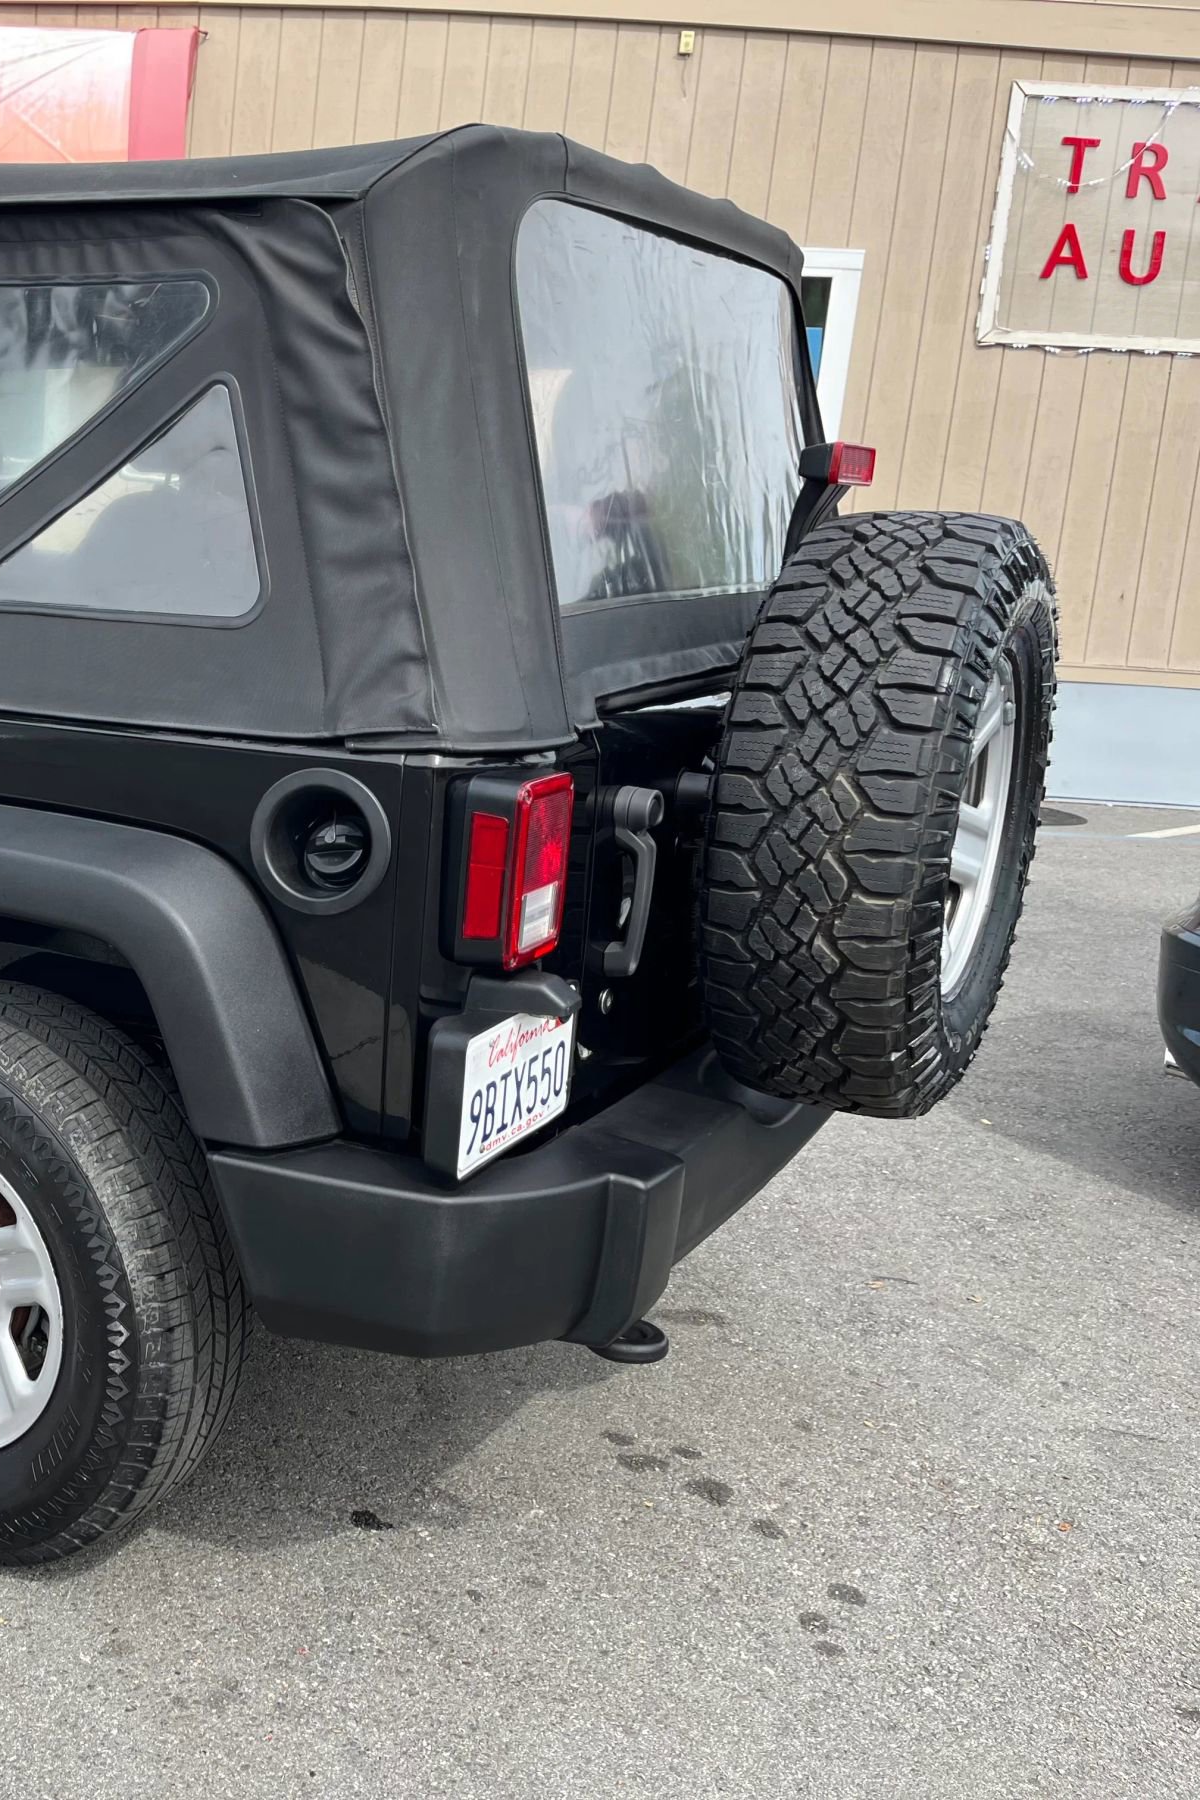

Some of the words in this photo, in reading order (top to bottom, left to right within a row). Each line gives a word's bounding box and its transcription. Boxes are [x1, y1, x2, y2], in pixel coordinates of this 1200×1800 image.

[1061, 136, 1200, 204] TR
[1039, 223, 1167, 286] AU
[488, 1017, 557, 1068] California
[466, 1040, 566, 1155] 9BIX550
[485, 1110, 544, 1152] dmv.ca.gov
